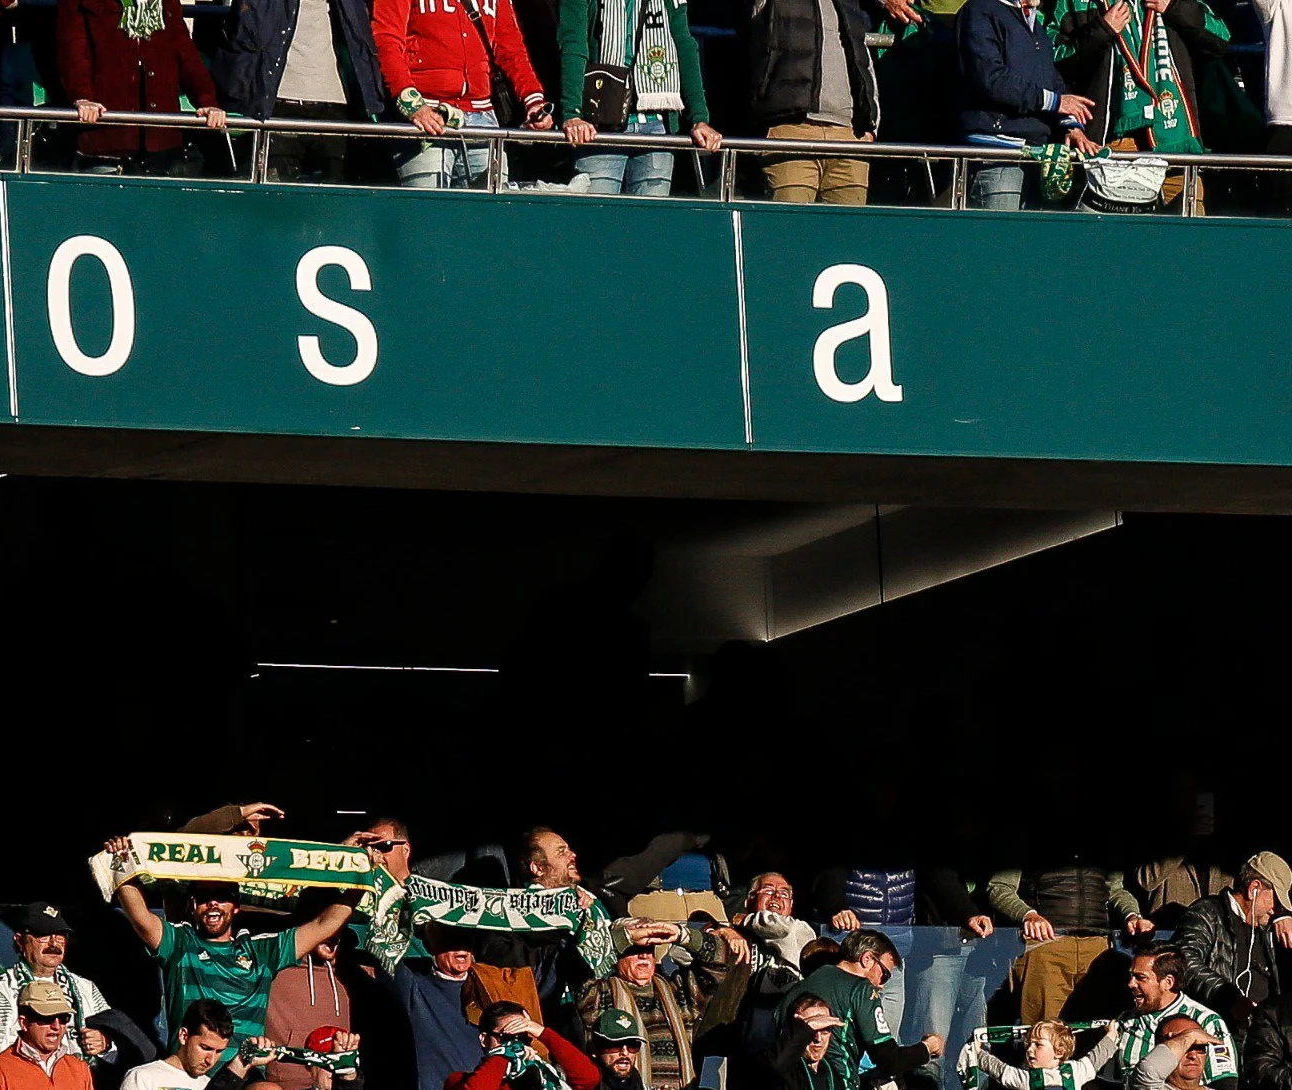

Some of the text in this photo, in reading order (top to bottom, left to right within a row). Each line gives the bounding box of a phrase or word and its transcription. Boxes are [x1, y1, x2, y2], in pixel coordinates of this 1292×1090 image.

[813, 264, 902, 402] a
[148, 843, 370, 873] REAL BETIS
[557, 892, 579, 915] eal
